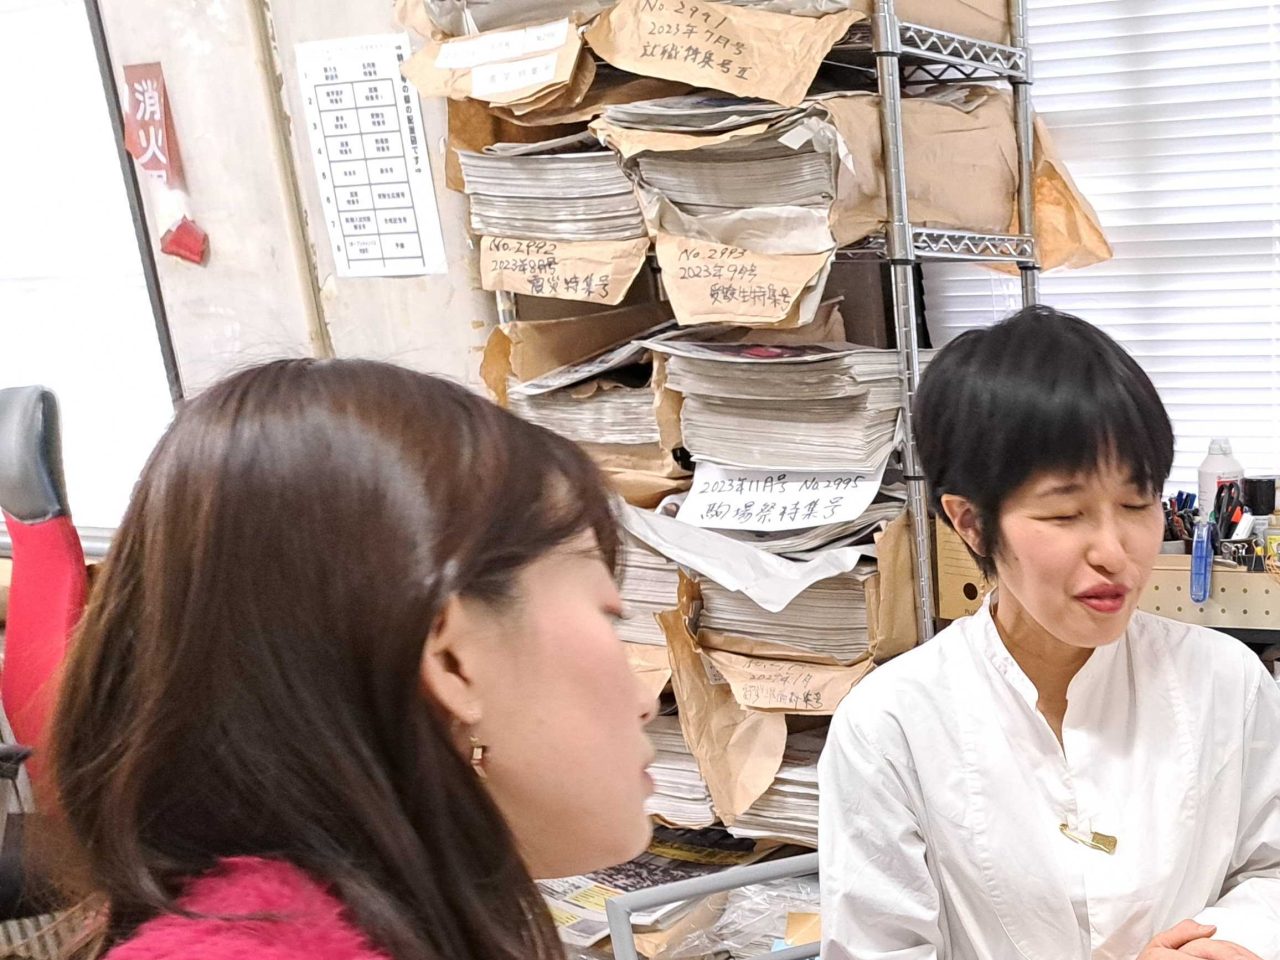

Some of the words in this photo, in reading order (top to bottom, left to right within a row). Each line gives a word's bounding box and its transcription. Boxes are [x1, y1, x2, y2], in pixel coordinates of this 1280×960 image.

[647, 21, 746, 56] 2023年7月号
[527, 274, 610, 299] 震災特集号
[699, 473, 790, 494] 2023年11月号
[700, 496, 844, 524] 駒場祭特集号
